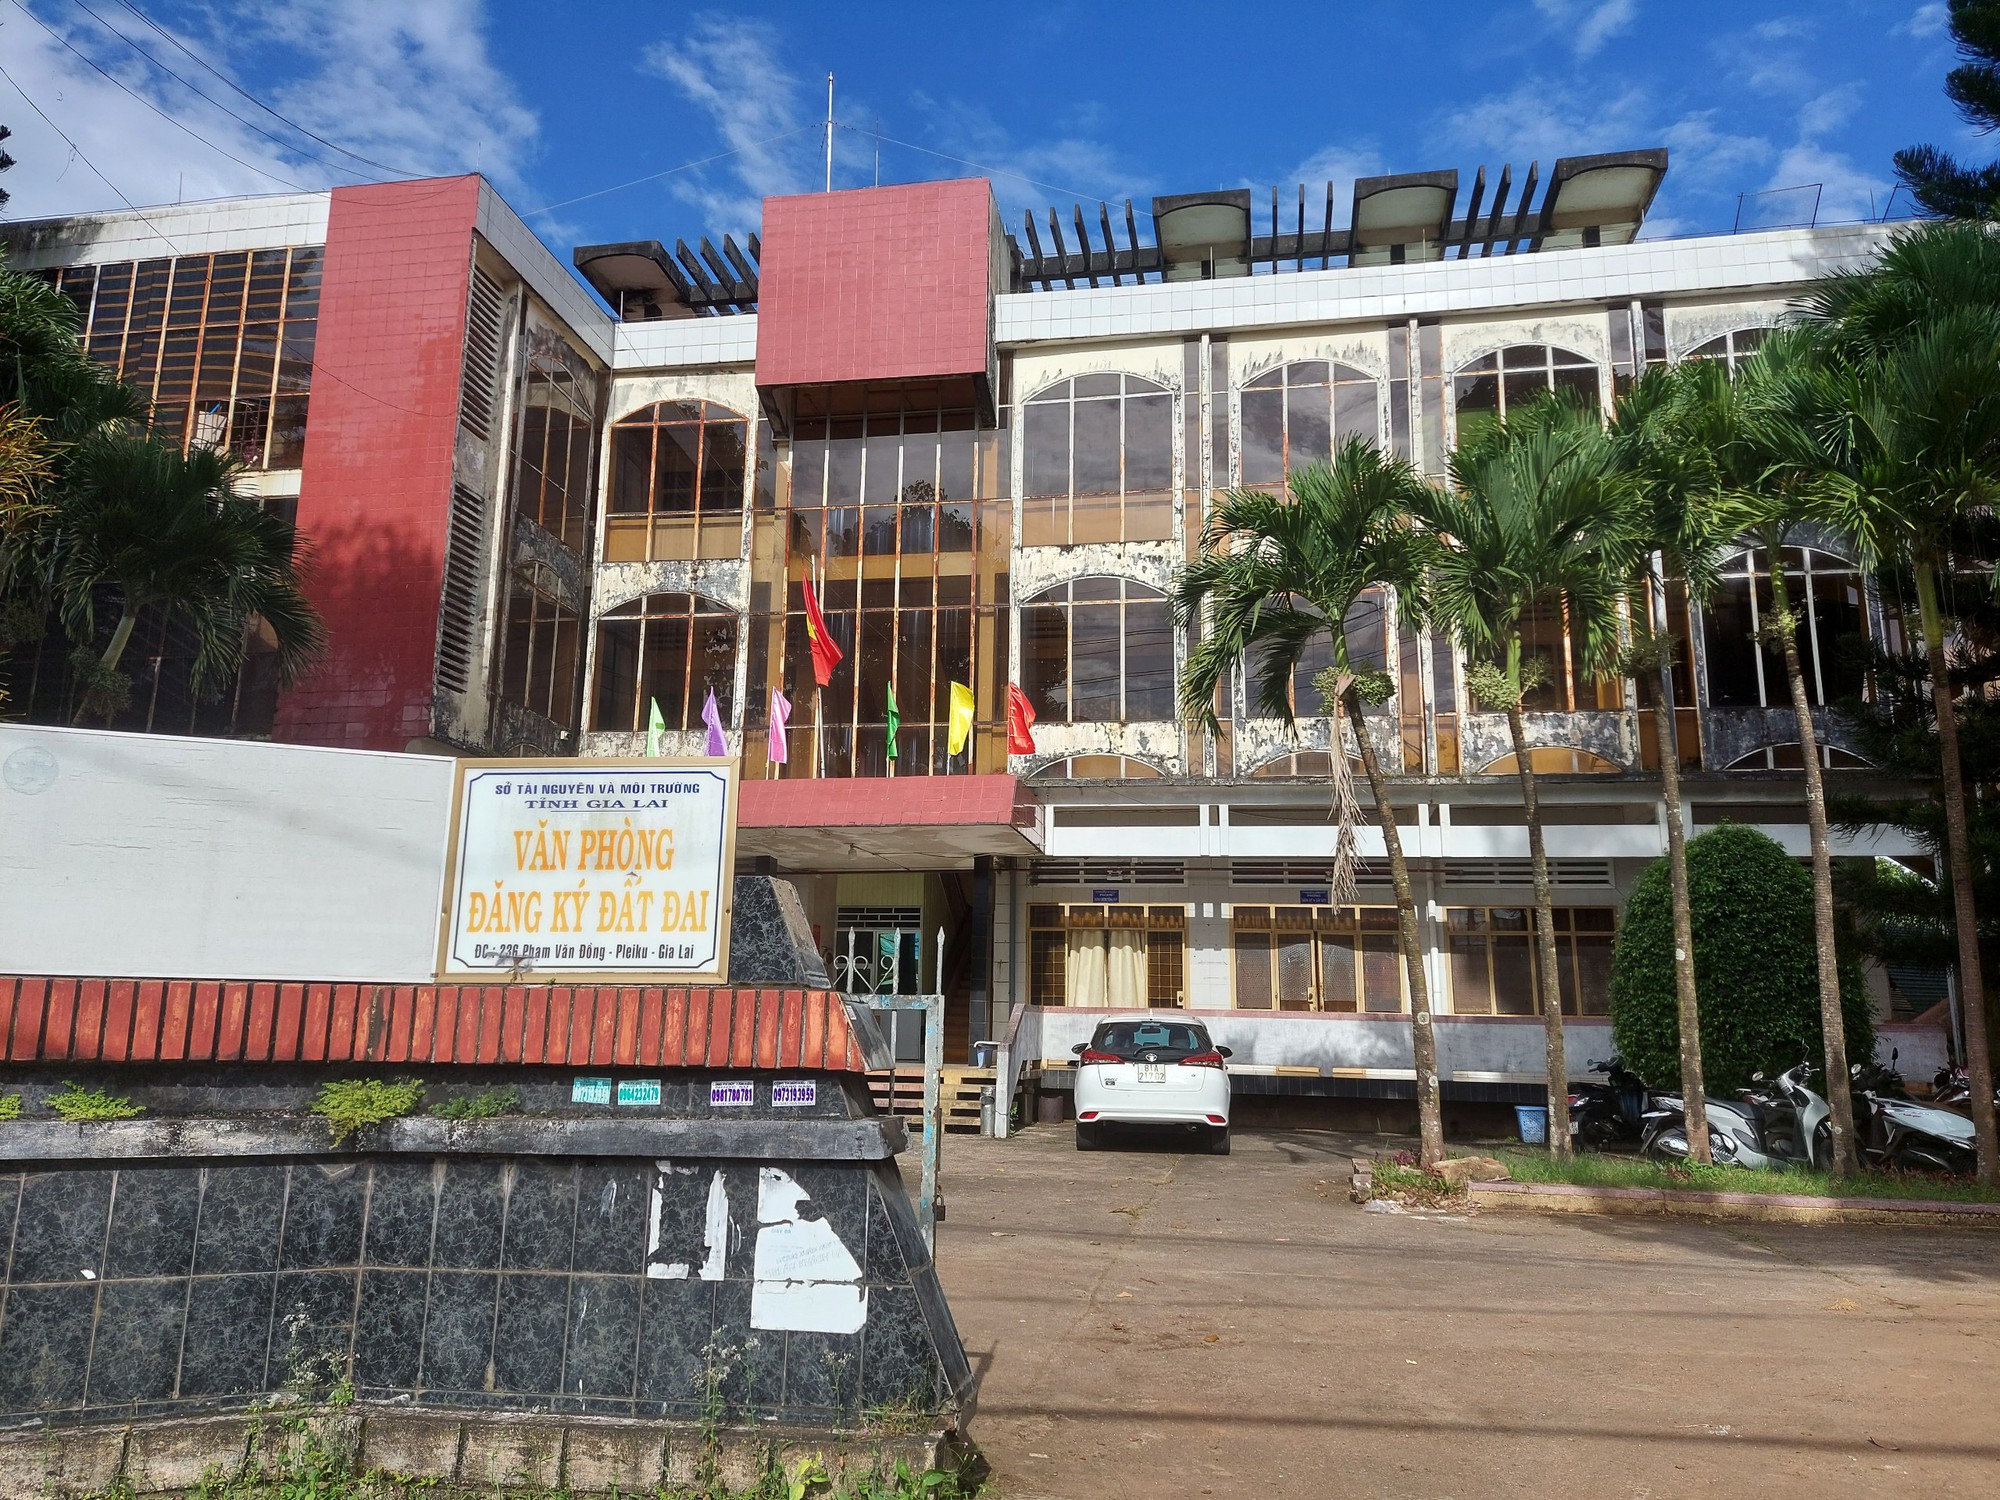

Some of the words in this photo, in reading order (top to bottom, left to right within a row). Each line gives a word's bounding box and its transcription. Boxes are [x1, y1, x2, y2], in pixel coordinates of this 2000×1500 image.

[495, 781, 511, 795] SỞ
[517, 782, 538, 795] TÀI
[541, 782, 594, 795] NGUYÊN
[599, 782, 615, 794] VÀ
[620, 782, 645, 794] MÔI
[650, 781, 701, 794] TRƯỜNG
[524, 797, 578, 809] TỈNH
[586, 799, 627, 809] GIA
[632, 799, 669, 808] LAI
[514, 819, 570, 871] VĂN
[577, 816, 675, 871] PHÒNG
[466, 880, 542, 933] ĐĂNG
[550, 878, 590, 933] KÝ
[596, 876, 654, 933] ĐẤT
[661, 891, 709, 932] ĐAI
[499, 944, 519, 958] 236
[522, 944, 550, 962] Phạm
[555, 943, 575, 959] Văn
[579, 942, 605, 961] Đồng
[615, 943, 648, 959] Pleiku
[658, 943, 675, 959] Gia
[679, 943, 694, 959] Lai
[1145, 1064, 1159, 1072] 81A
[773, 1087, 814, 1102] 0973193959
